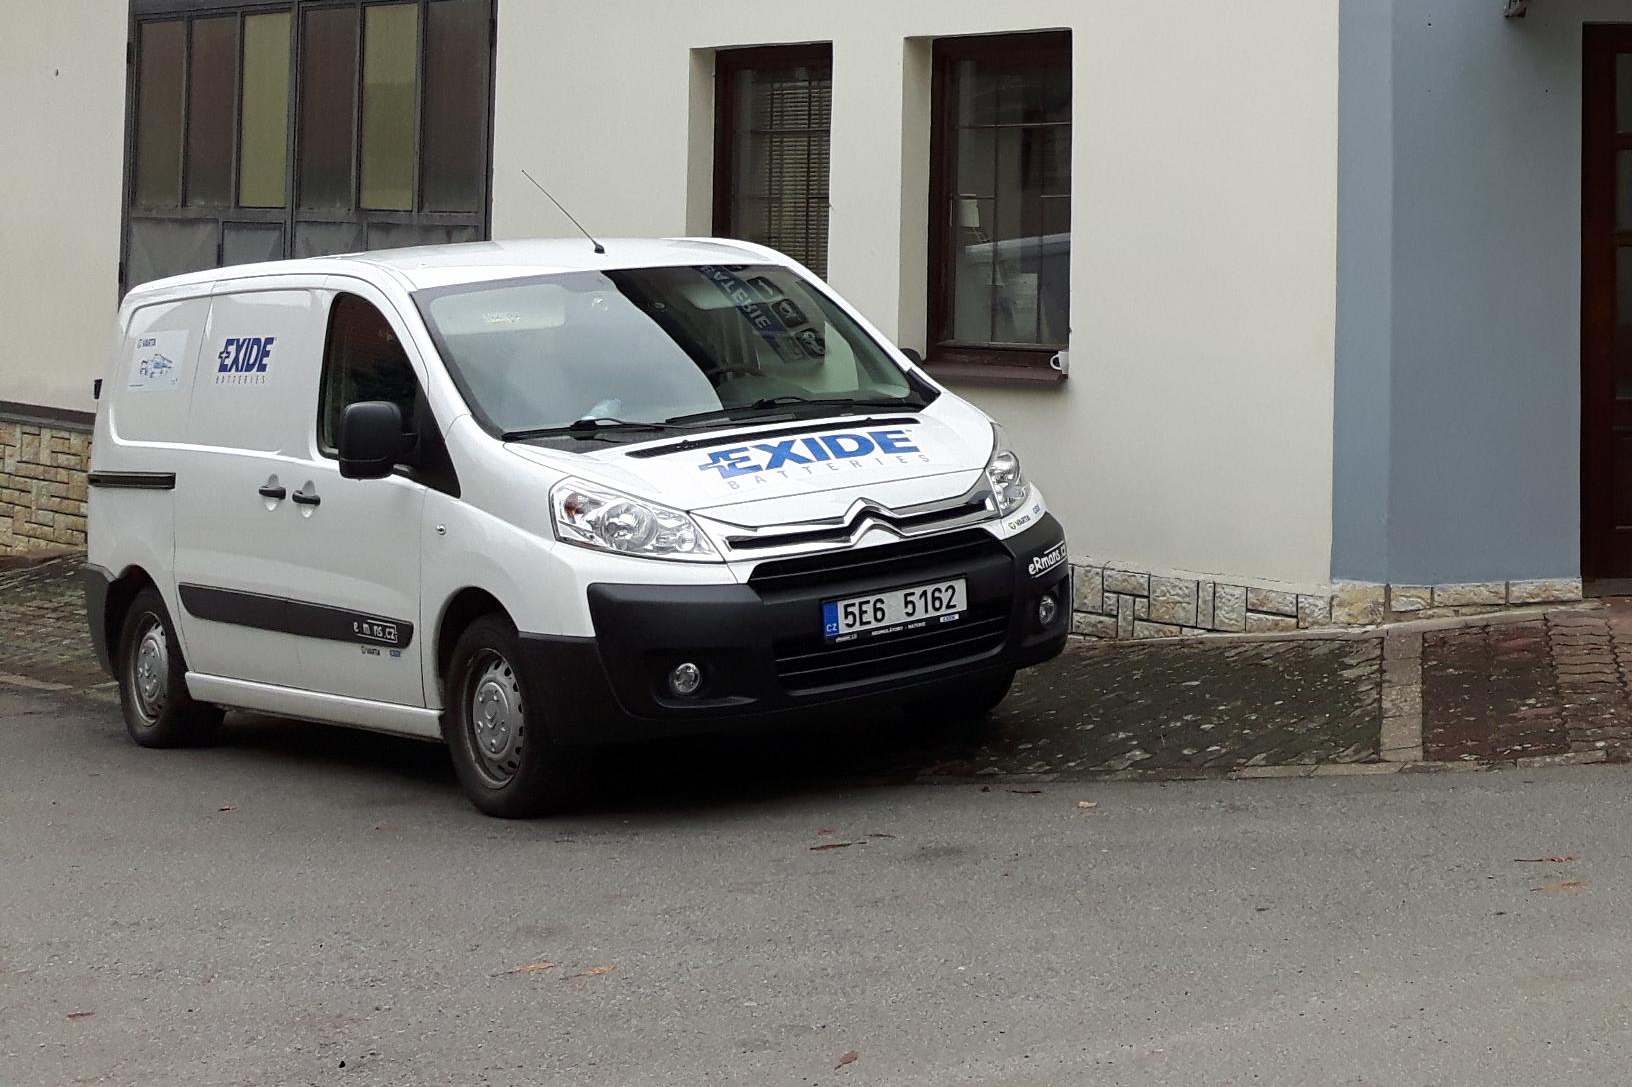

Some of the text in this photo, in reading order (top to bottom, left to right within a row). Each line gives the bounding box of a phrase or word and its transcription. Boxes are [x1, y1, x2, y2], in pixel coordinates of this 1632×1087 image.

[217, 336, 275, 373] EXIDE
[698, 430, 921, 479] EXIDE
[728, 454, 930, 490] BATTERIES
[826, 584, 957, 632] CZ 5E6 5162
